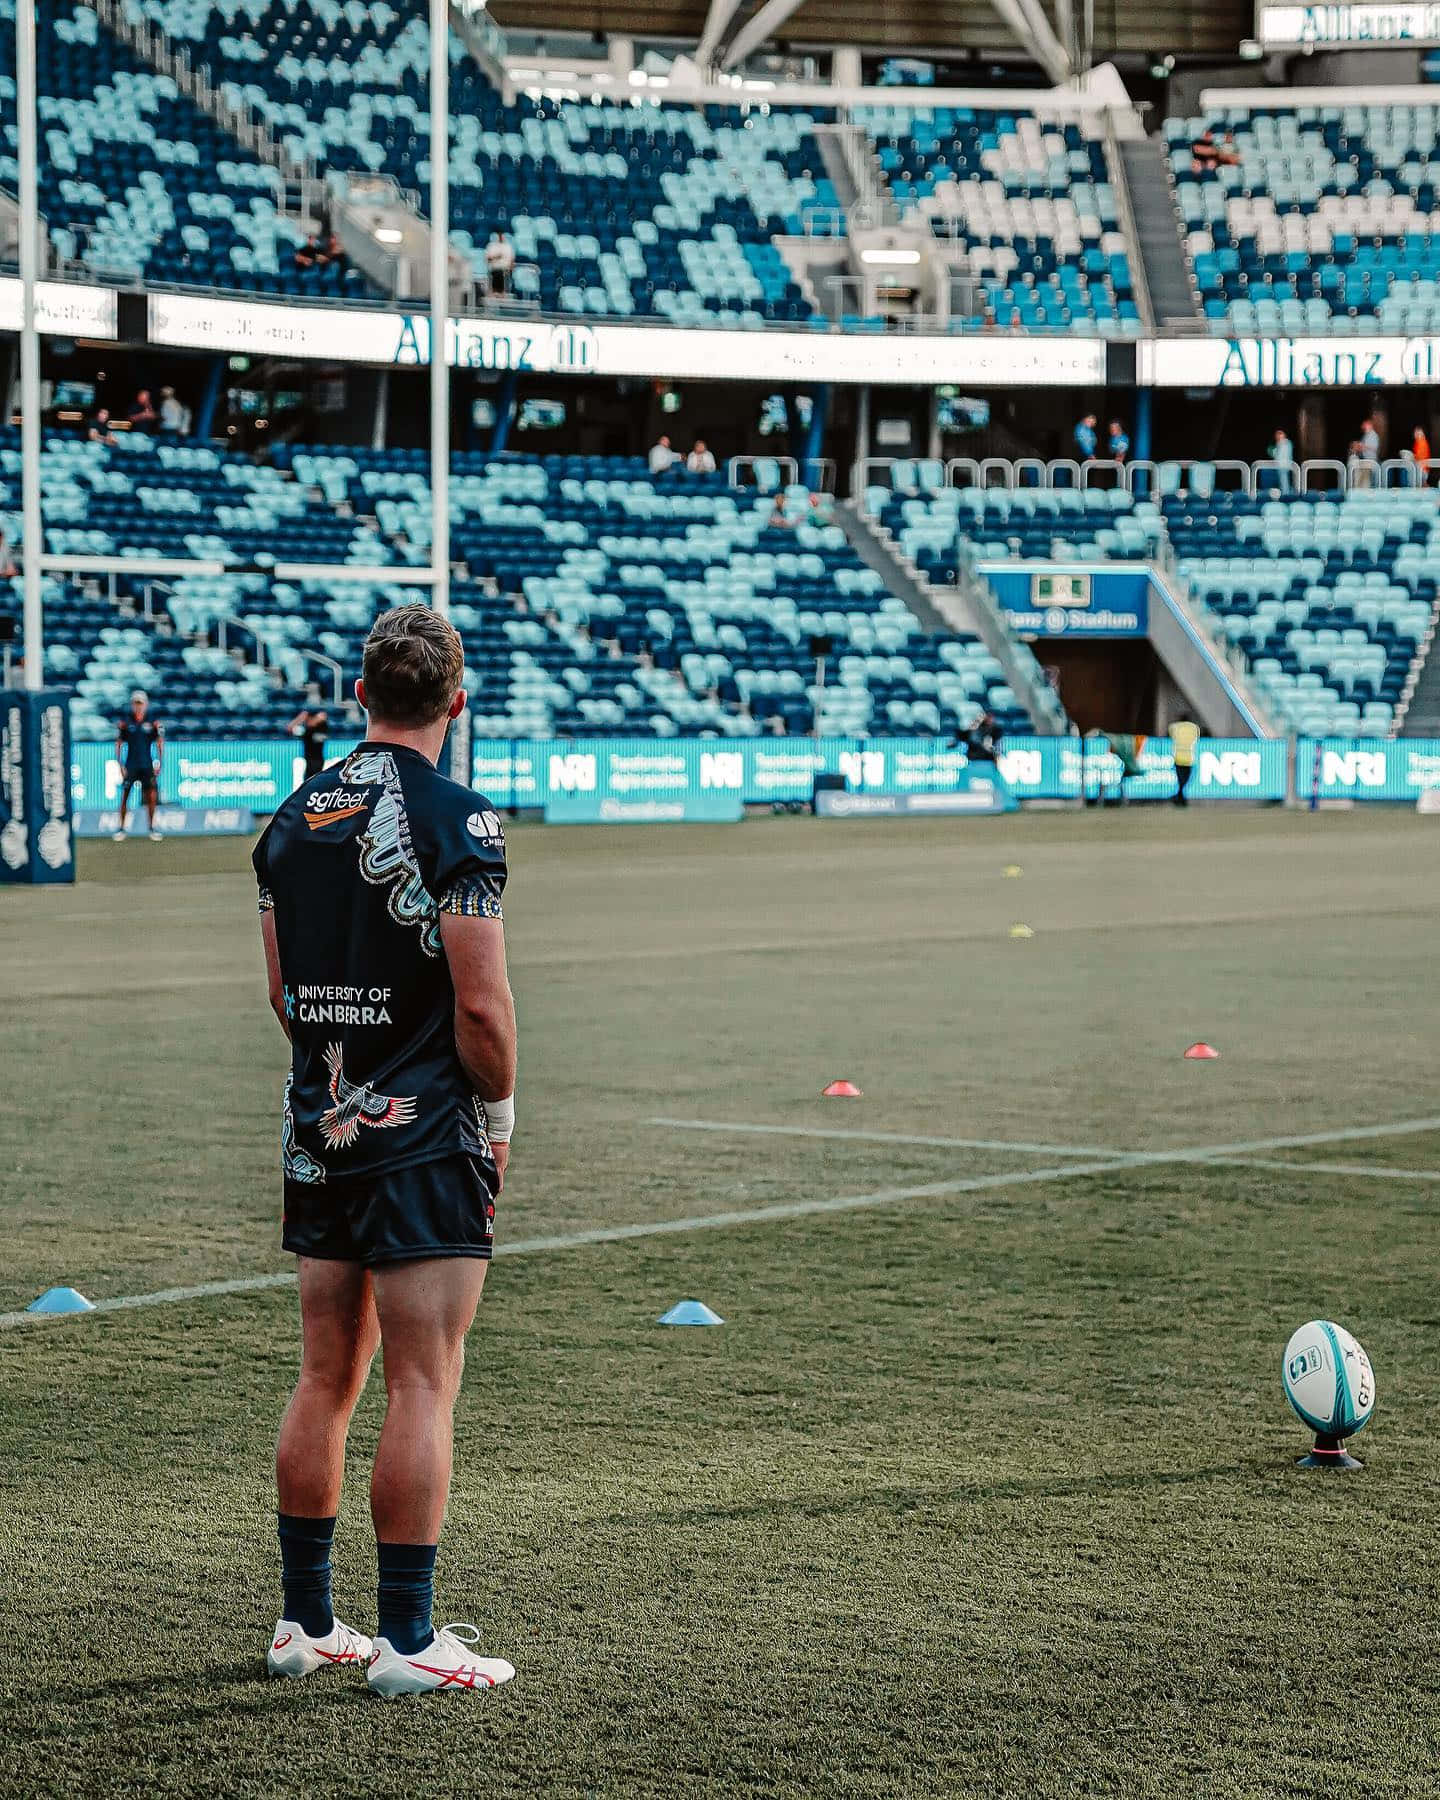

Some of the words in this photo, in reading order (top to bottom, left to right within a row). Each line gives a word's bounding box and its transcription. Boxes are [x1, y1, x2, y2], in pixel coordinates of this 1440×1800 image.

[393, 316, 533, 371] Alianz
[1219, 337, 1384, 385] Allianz
[306, 787, 370, 812] sgfleet
[298, 984, 364, 1002] UNIVERSITY
[368, 987, 391, 1002] OF
[299, 1003, 393, 1025] CANBERRA
